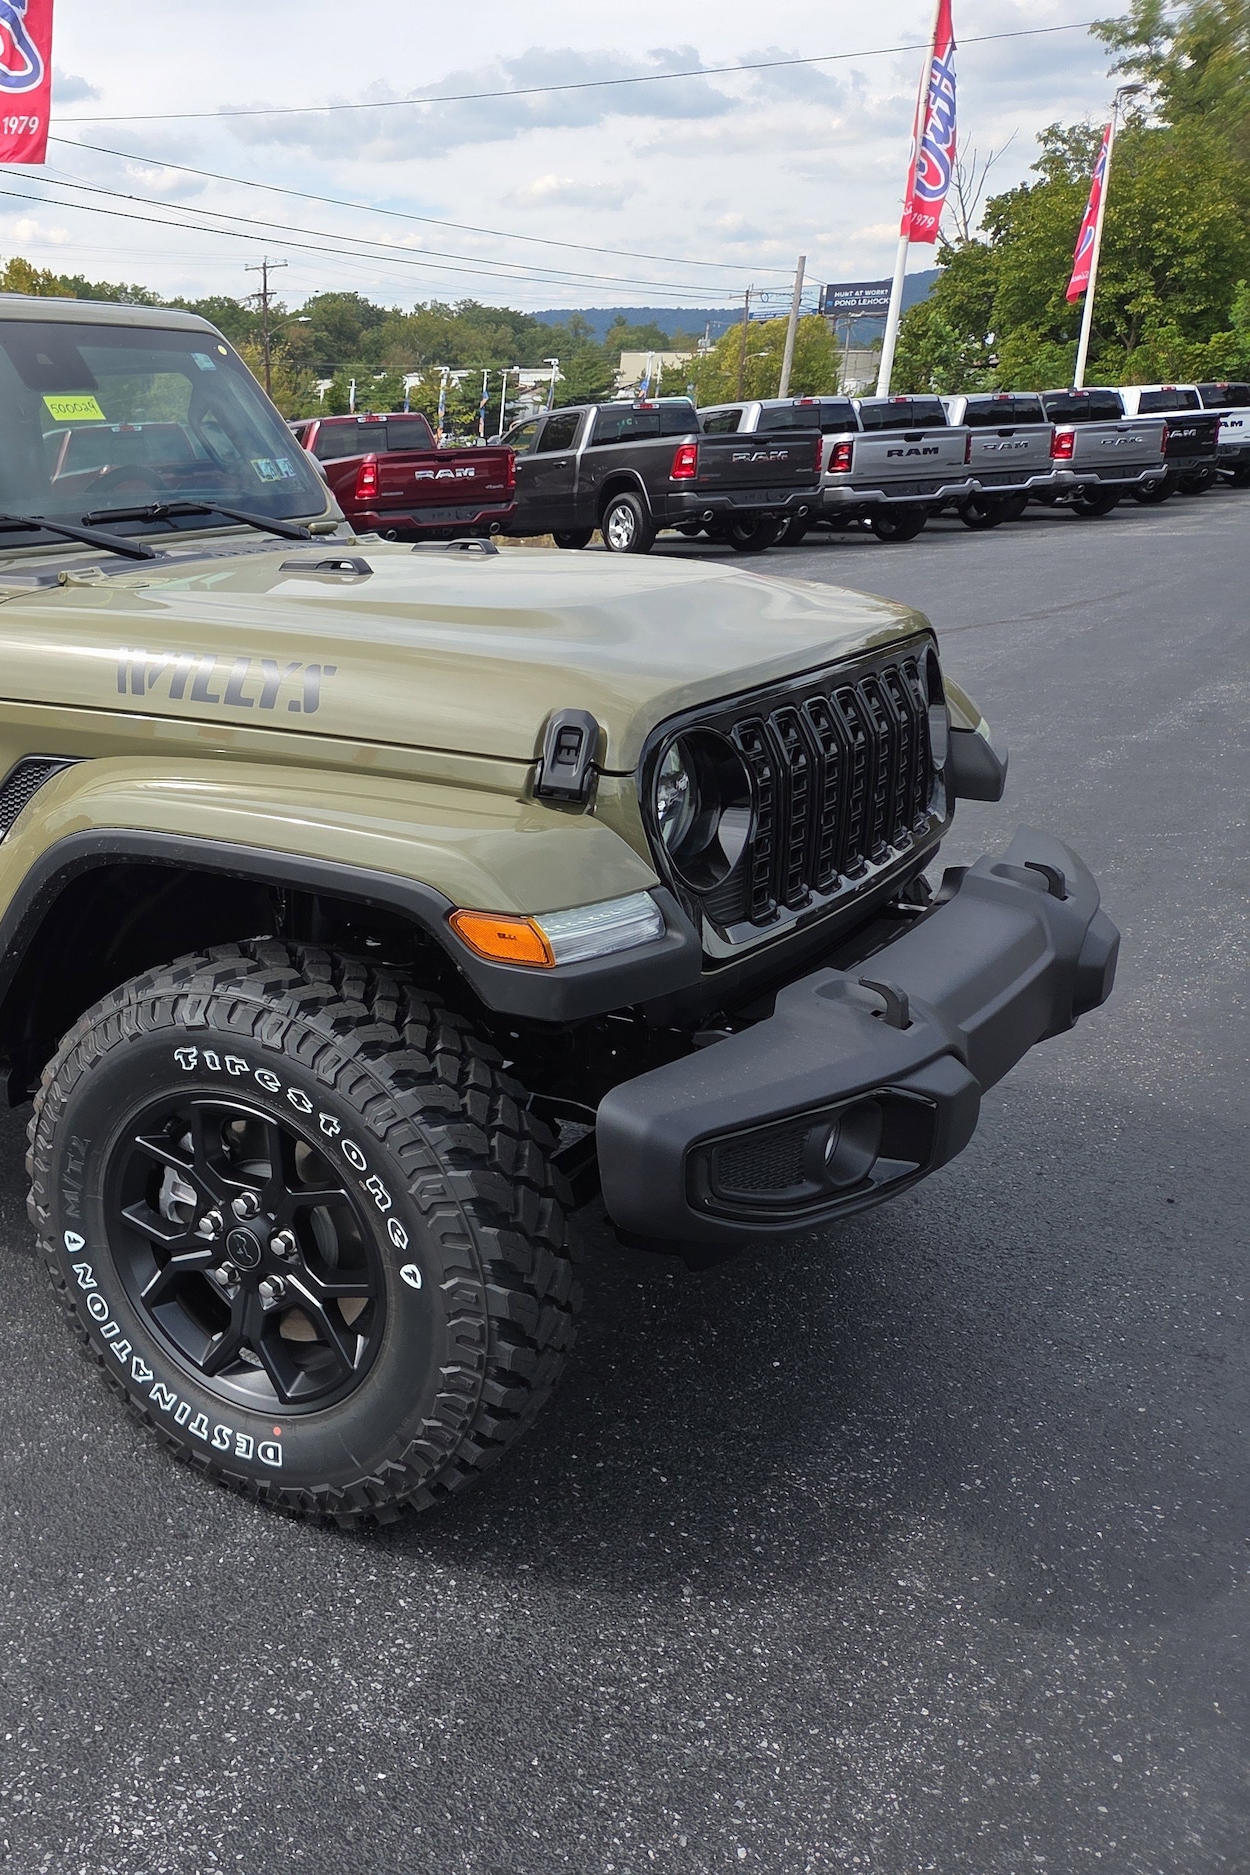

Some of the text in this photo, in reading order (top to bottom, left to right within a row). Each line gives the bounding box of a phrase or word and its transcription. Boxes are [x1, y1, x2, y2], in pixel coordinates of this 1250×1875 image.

[2, 116, 39, 135] 1979
[911, 213, 935, 228] 1979
[834, 299, 856, 307] POND
[1221, 420, 1243, 428] AM
[887, 446, 940, 458] RAM
[982, 440, 1029, 451] RAM
[732, 450, 789, 462] RAM
[415, 467, 475, 480] RAM
[117, 647, 337, 714] WILLYS
[174, 1046, 409, 1250] Firestone
[72, 1261, 283, 1467] DESTINATION
